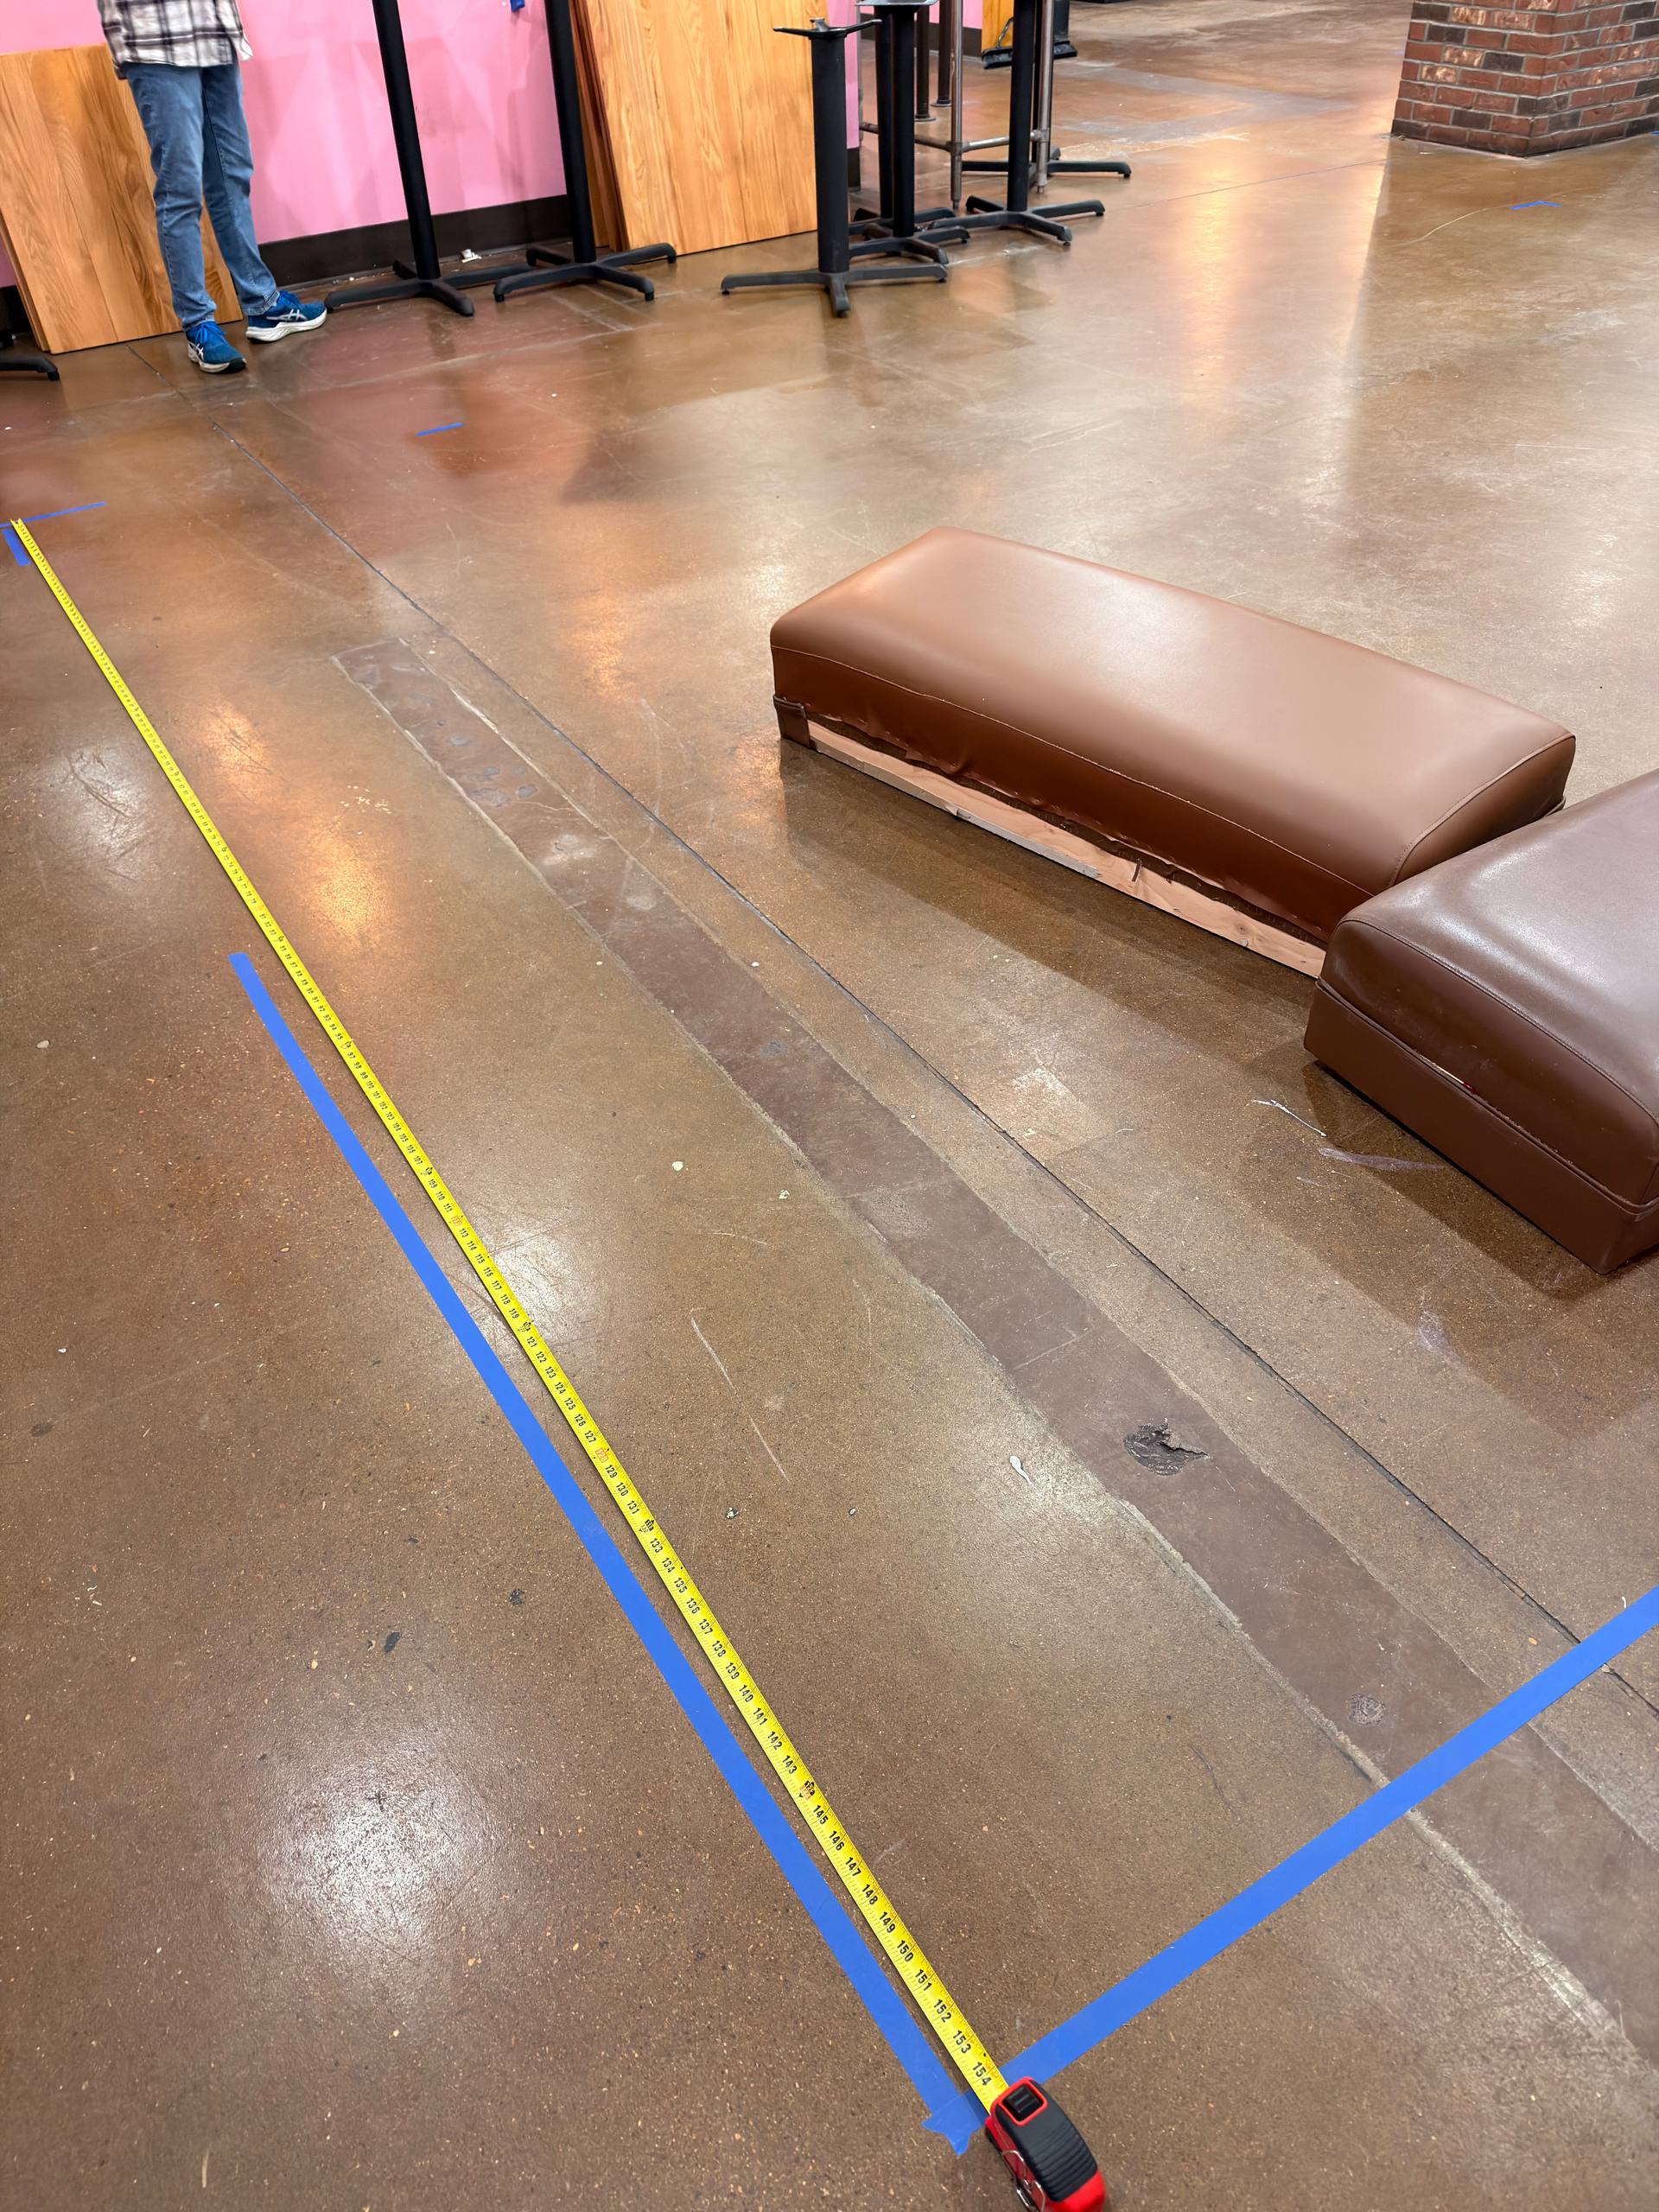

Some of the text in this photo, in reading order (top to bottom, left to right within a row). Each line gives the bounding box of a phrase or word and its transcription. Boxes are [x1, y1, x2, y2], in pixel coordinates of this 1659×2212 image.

[459, 1228, 469, 1238] 113
[467, 1241, 477, 1250] 114
[475, 1254, 485, 1264] 115
[483, 1267, 494, 1277] 116
[492, 1280, 502, 1290] 117
[500, 1294, 511, 1305] 118
[509, 1308, 520, 1319] 119
[526, 1336, 537, 1348] 121
[536, 1351, 547, 1363] 122
[545, 1366, 557, 1379] 123
[554, 1382, 566, 1394] 124
[564, 1397, 576, 1410] 125
[574, 1413, 586, 1427] 126
[584, 1430, 597, 1443] 127
[605, 1464, 618, 1478] 129
[616, 1482, 629, 1497] 130
[627, 1500, 640, 1514] 131
[650, 1538, 663, 1553] 133
[662, 1557, 675, 1573] 134
[674, 1577, 688, 1593] 135
[686, 1597, 700, 1614] 136
[699, 1618, 713, 1635] 137
[712, 1640, 726, 1657] 138
[725, 1662, 740, 1680] 139
[739, 1684, 754, 1703] 140
[753, 1707, 768, 1726] 141
[767, 1731, 783, 1750] 142
[782, 1755, 798, 1774] 143
[813, 1804, 829, 1825] 145
[829, 1830, 845, 1851] 146
[845, 1857, 862, 1876] 147
[862, 1883, 878, 1905] 148
[879, 1911, 896, 1933] 149
[897, 1939, 914, 1962] 150
[915, 1969, 932, 1991] 151
[934, 1999, 952, 2023] 152
[953, 2030, 971, 2054] 153
[973, 2061, 992, 2086] 154
